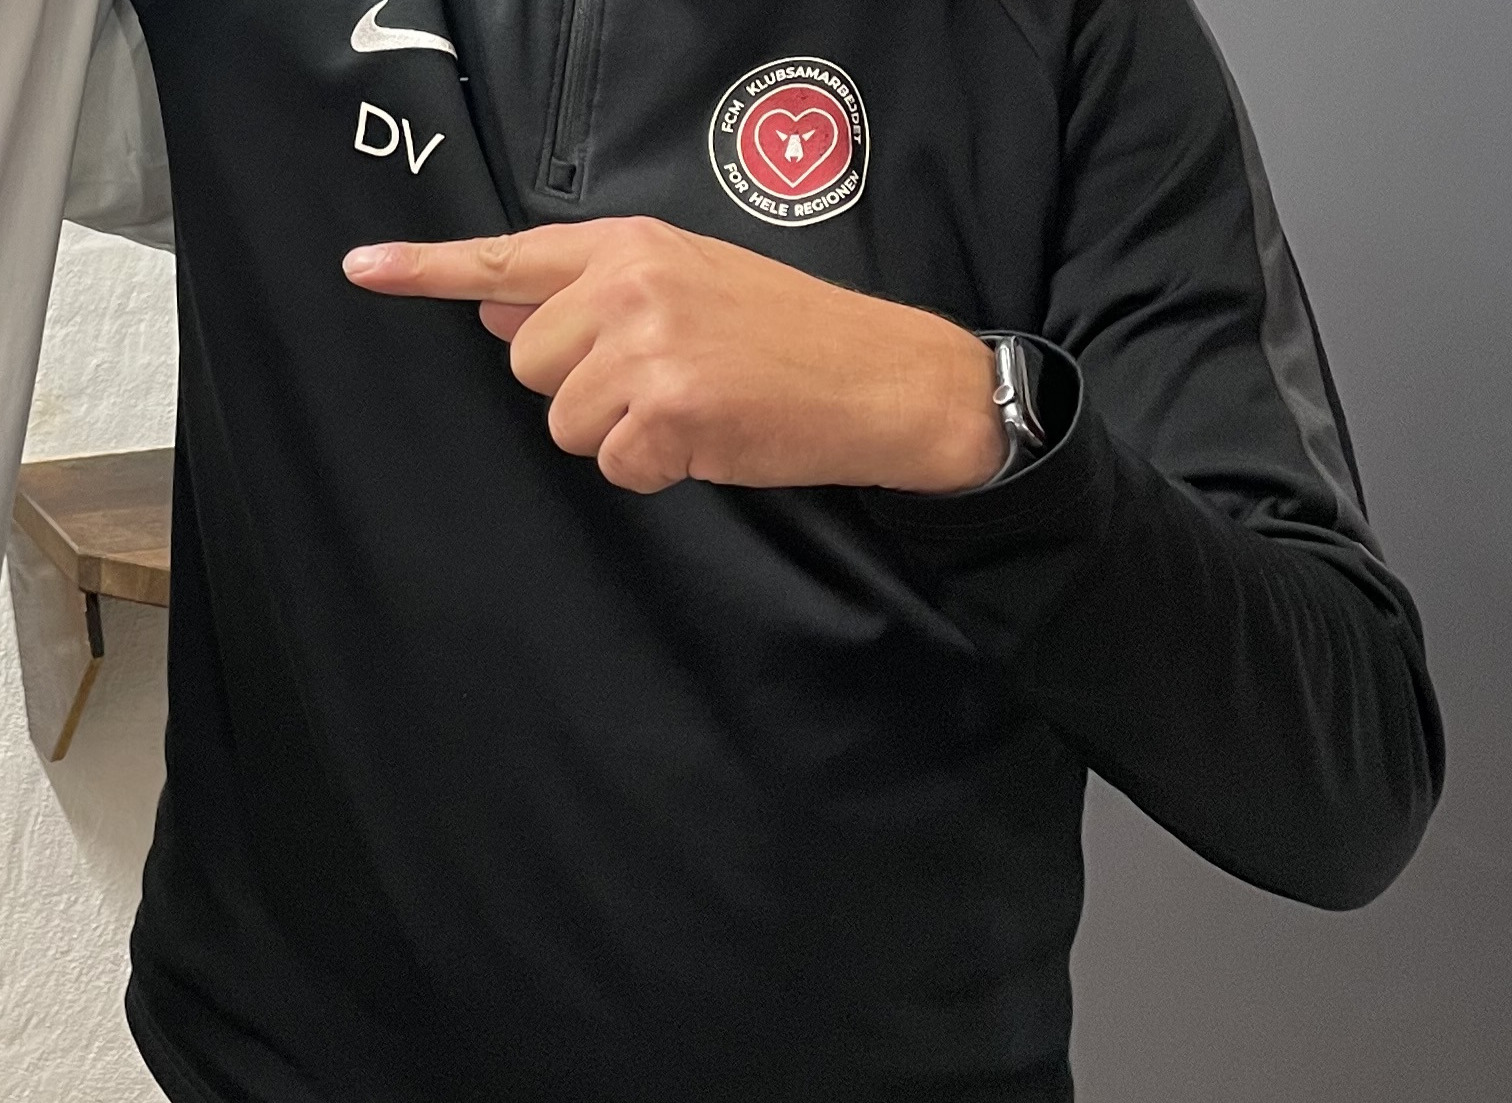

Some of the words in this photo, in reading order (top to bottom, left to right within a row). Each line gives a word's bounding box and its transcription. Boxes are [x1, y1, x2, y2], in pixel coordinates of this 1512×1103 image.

[354, 101, 446, 175] DV
[721, 99, 745, 134] FCM
[745, 65, 863, 146] KLUBSAMARBEJDET
[723, 162, 750, 194] FOR
[748, 190, 790, 217] HELE
[793, 169, 861, 217] REGIONEN
